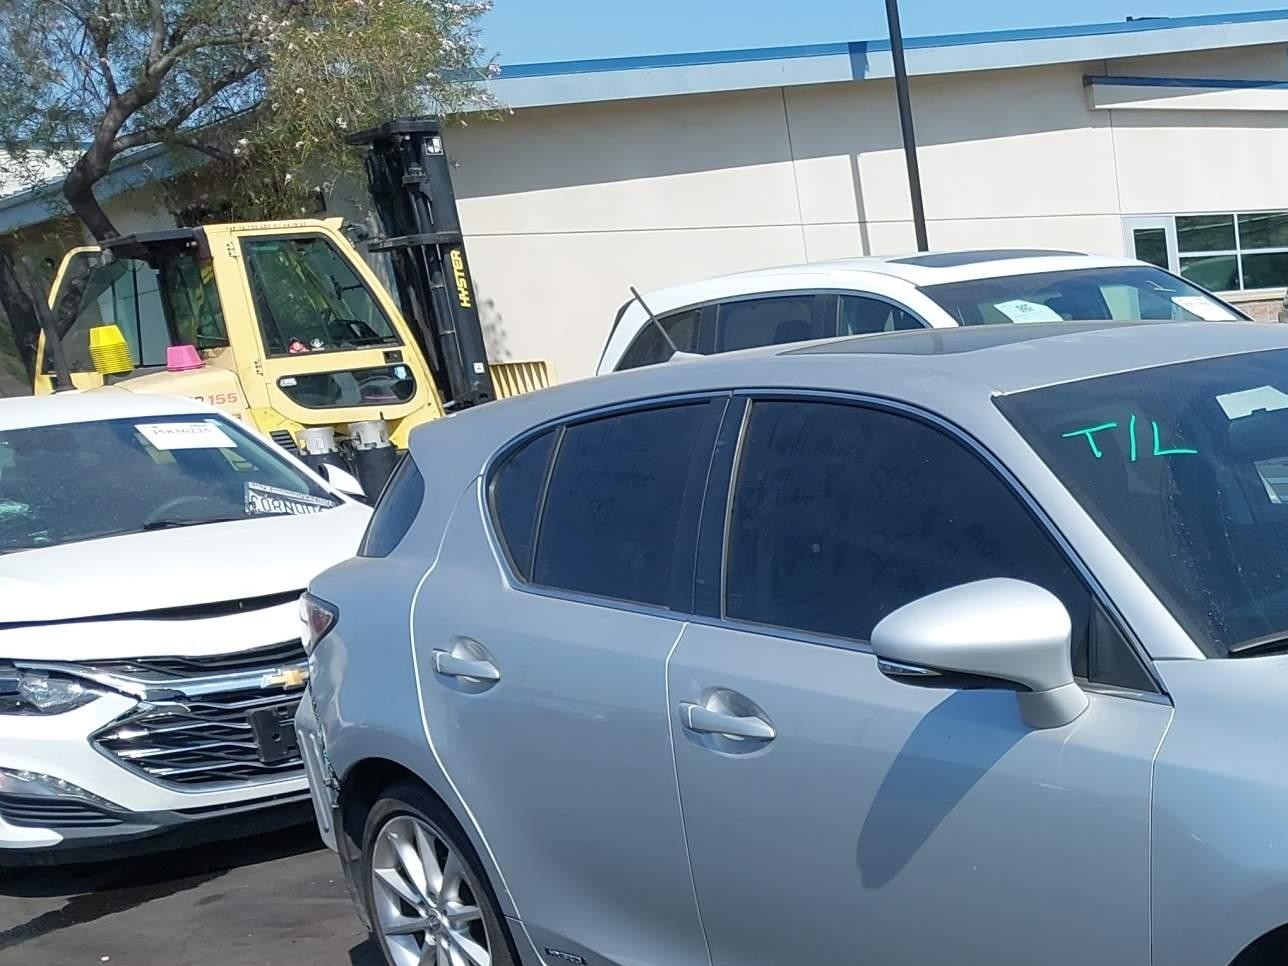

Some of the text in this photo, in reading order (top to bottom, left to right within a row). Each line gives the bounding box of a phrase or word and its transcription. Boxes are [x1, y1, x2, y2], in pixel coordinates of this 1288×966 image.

[450, 249, 471, 307] HYSTER
[207, 392, 238, 405] 155
[1061, 415, 1198, 461] T/L
